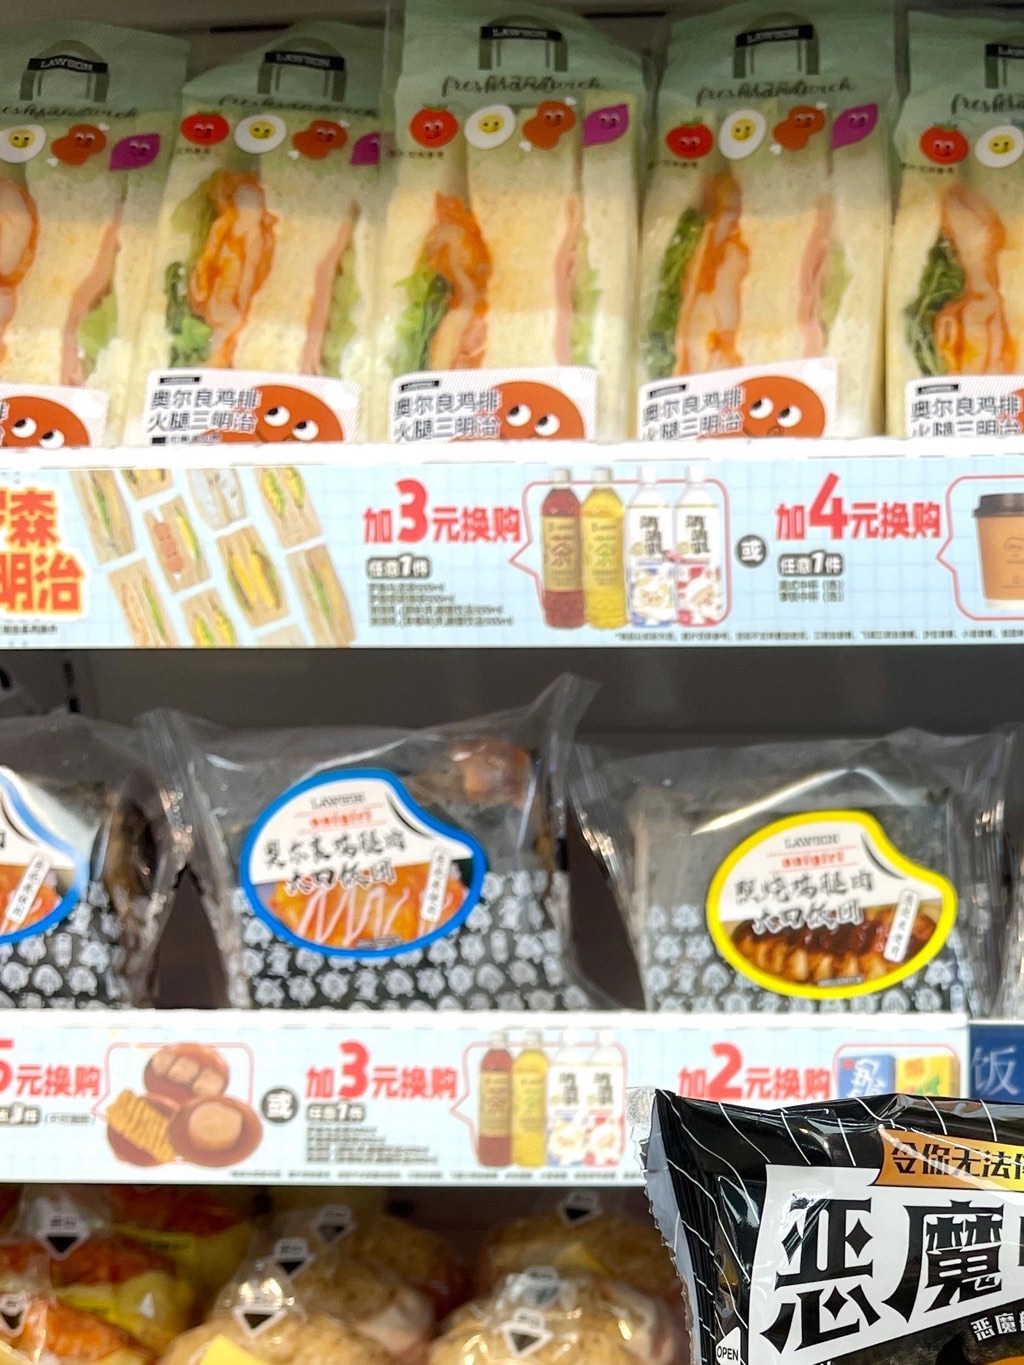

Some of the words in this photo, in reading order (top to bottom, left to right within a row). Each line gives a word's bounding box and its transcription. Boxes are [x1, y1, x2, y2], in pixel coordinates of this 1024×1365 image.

[150, 388, 261, 411] 奥尔良鸡排
[394, 390, 499, 422] 奥尔良鸡排
[642, 388, 742, 425] 奥尔良鸡排
[911, 395, 1020, 421] 奥尔良鸡排
[147, 411, 256, 434] 火腿三明治
[395, 411, 499, 440] 火腿三明治
[0, 486, 60, 549] 森
[363, 478, 522, 545] 加3元换购
[775, 473, 942, 540] 加4元换购
[740, 540, 763, 562] 或
[779, 551, 842, 574] 任意1件
[735, 869, 876, 904] 照烧鸡腿肉
[305, 1040, 458, 1100] 加3元换购
[678, 1041, 831, 1100] 加2元换购
[268, 1090, 292, 1118] 或
[716, 1343, 740, 1361] OPEN
